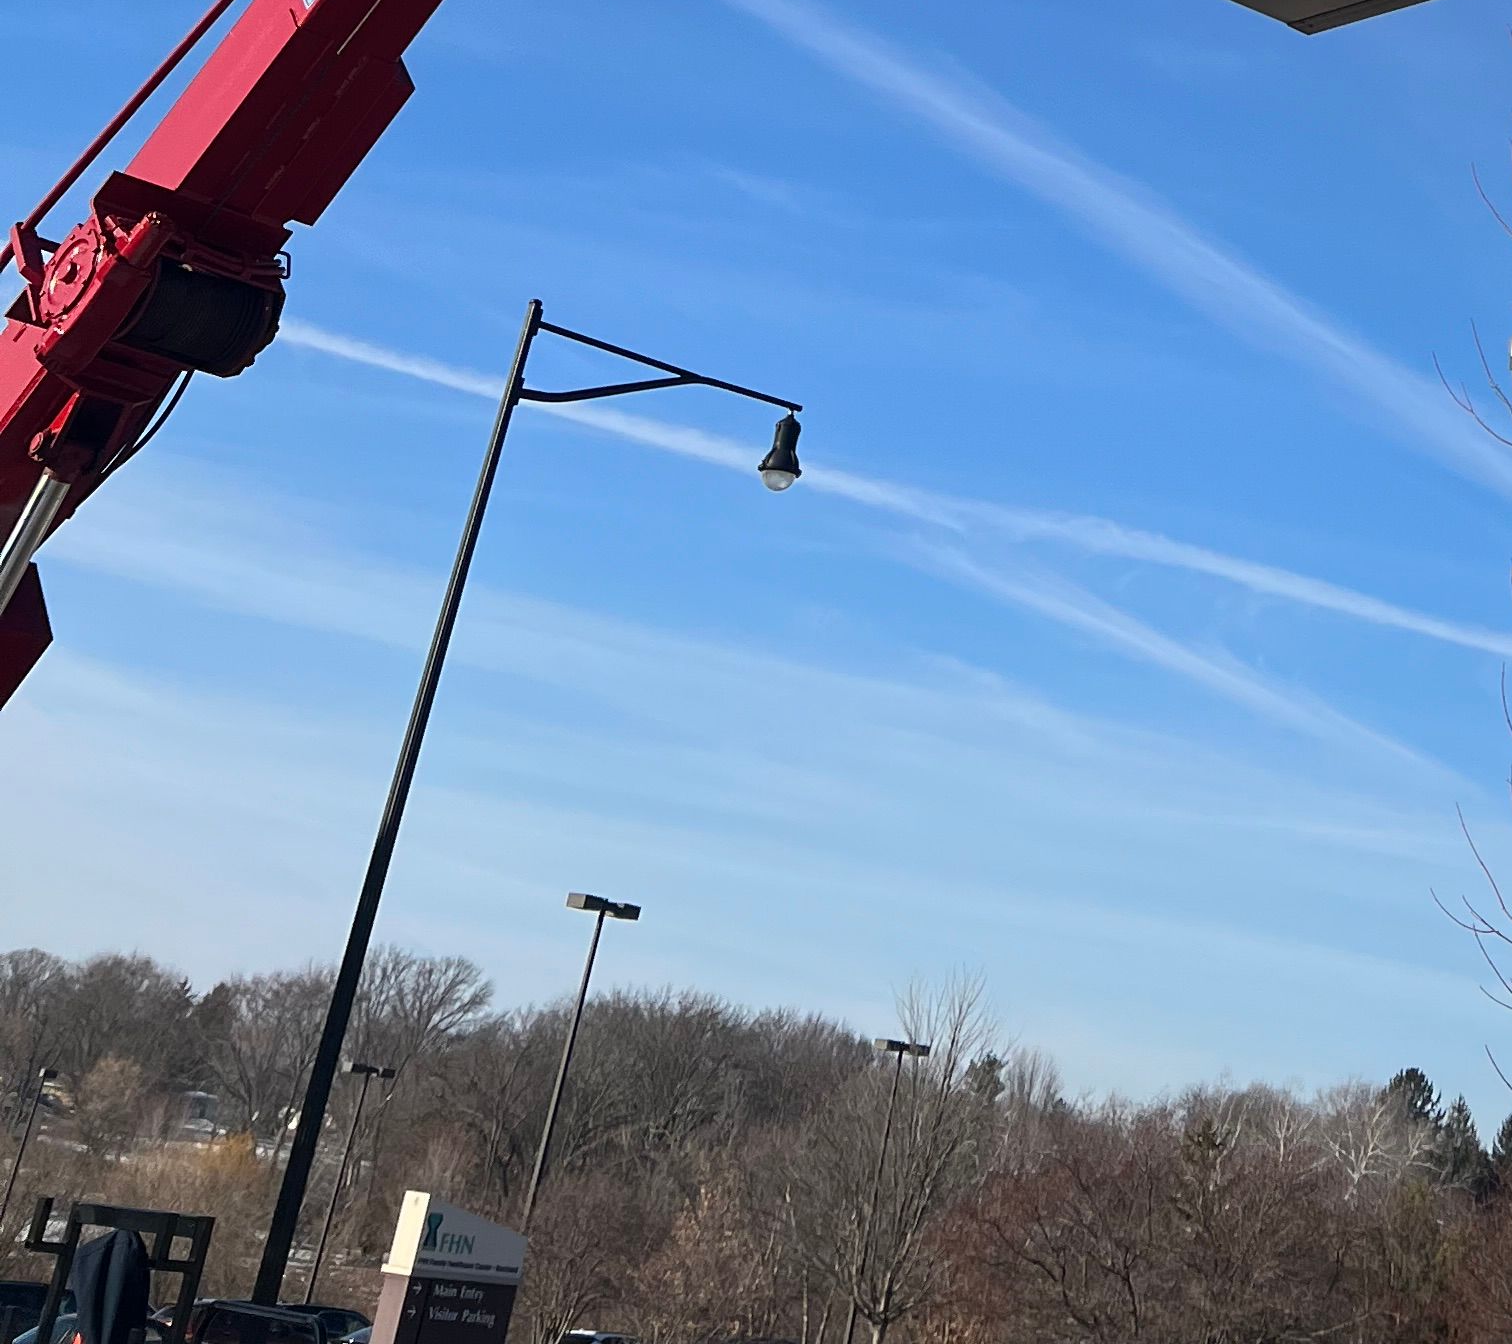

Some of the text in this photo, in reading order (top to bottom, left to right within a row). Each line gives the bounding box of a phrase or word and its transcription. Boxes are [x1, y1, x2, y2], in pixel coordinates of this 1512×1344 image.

[439, 1233, 476, 1255] FHN
[433, 1283, 458, 1297] Main
[461, 1309, 496, 1329] Parking
